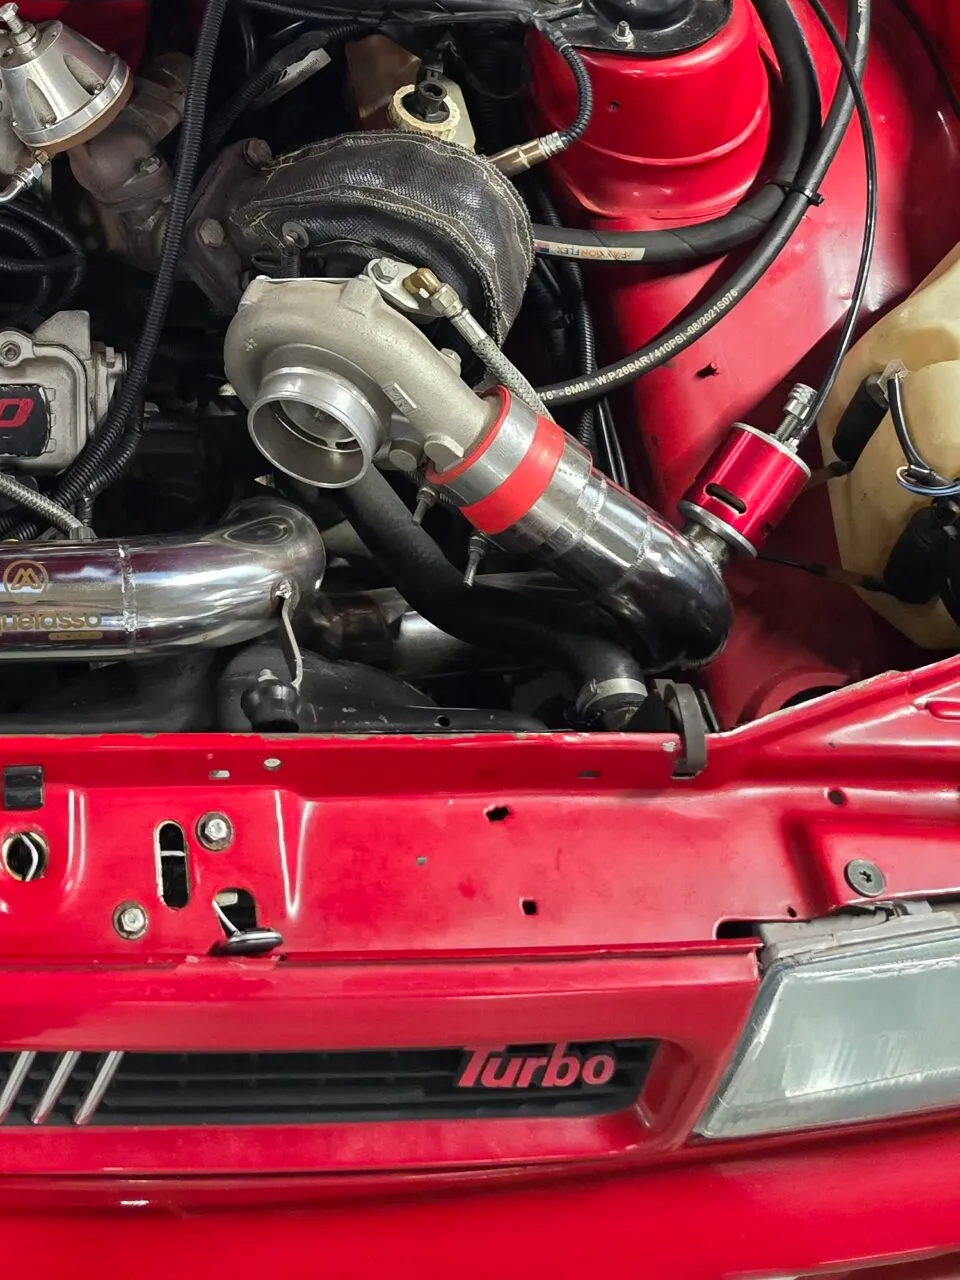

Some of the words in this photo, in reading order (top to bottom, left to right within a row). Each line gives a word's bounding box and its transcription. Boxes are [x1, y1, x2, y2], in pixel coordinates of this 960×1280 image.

[564, 381, 590, 396] 8MM
[654, 332, 687, 358] 410PSI
[457, 1042, 616, 1088] Turbo
